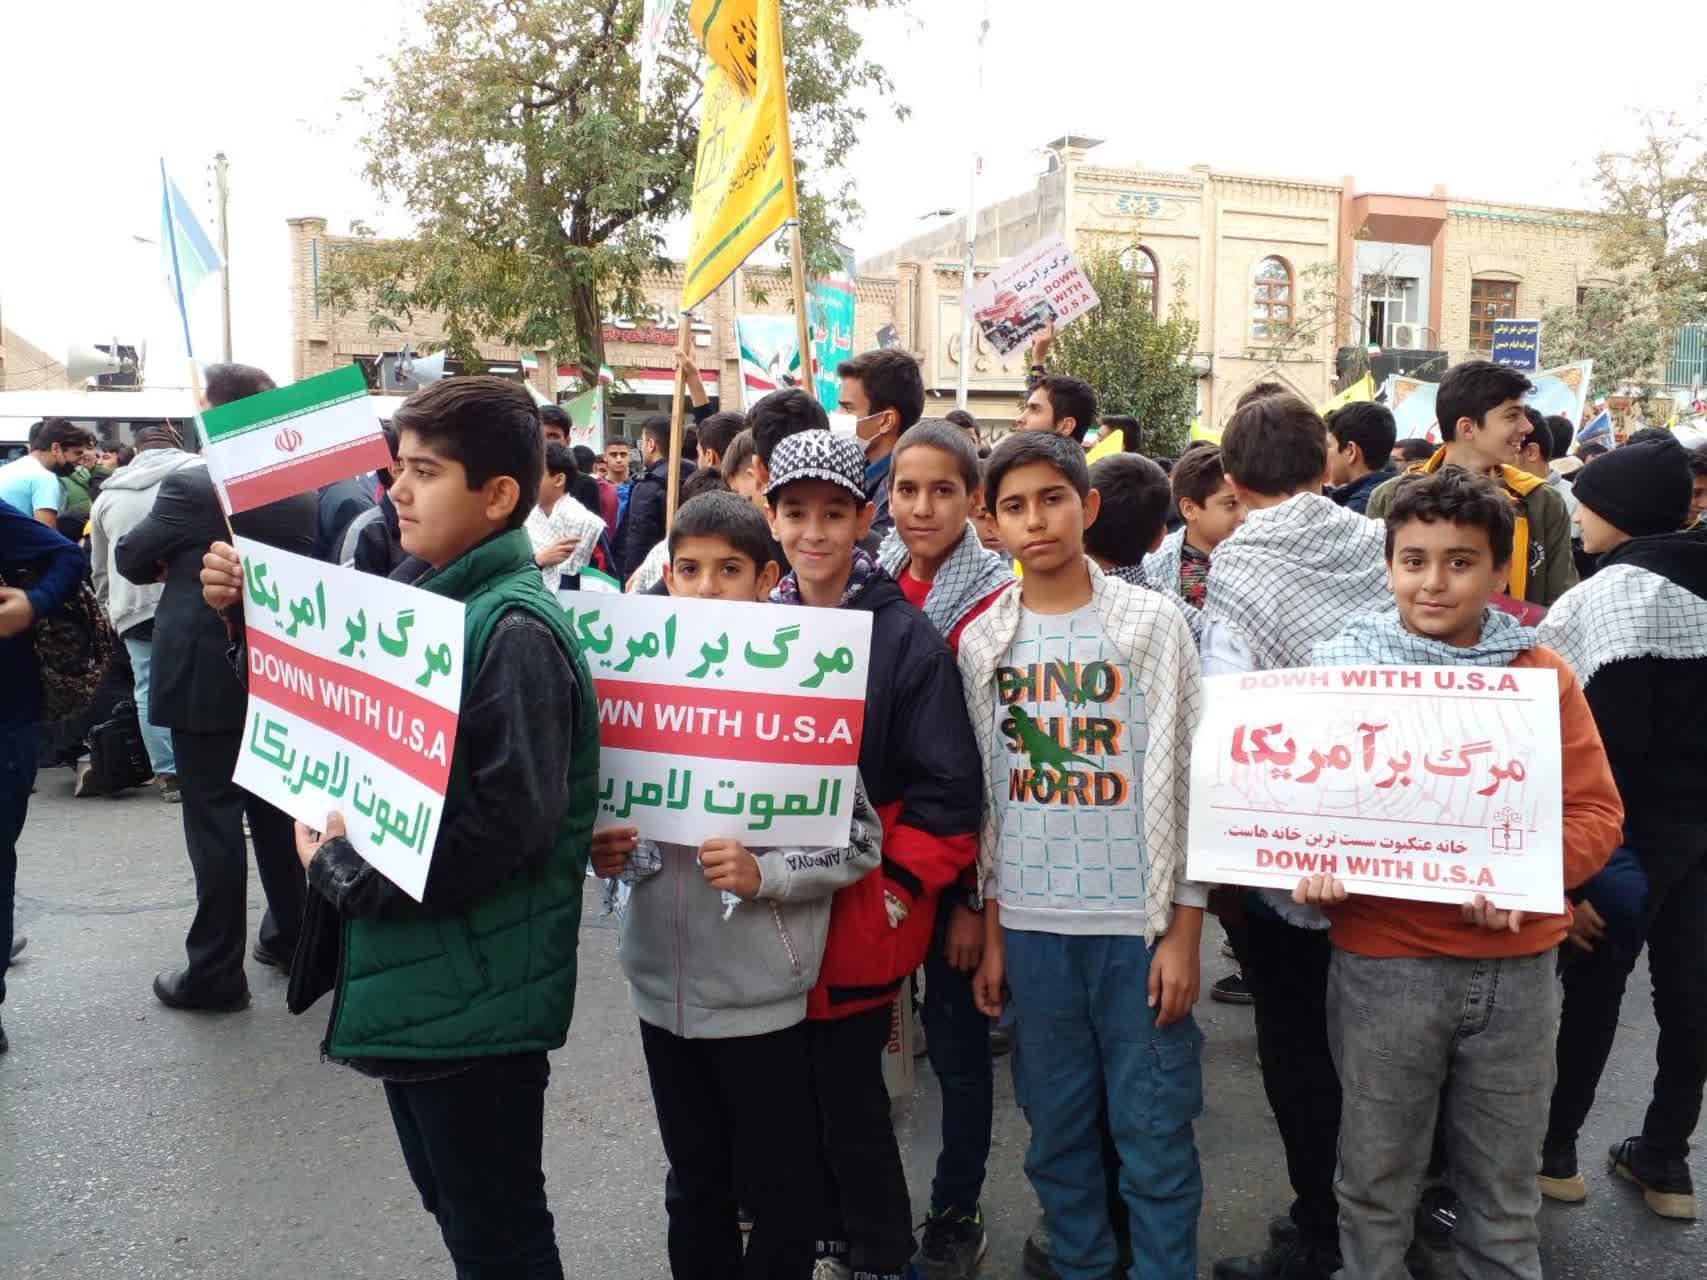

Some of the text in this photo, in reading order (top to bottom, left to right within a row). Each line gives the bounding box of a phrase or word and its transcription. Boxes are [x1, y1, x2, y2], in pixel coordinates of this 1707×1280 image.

[1043, 266, 1079, 296] DOWN
[1052, 281, 1084, 305] WITH
[244, 556, 452, 688] مرگ بر امریکا
[686, 632, 729, 678] بر
[743, 624, 854, 688] مرگ
[996, 660, 1123, 705] DINO
[1341, 669, 1422, 688] WITH
[1434, 671, 1520, 693] U.S.A
[250, 646, 447, 768] DOWN WITH U.S.A
[597, 697, 853, 744] WN WITH U.S.A
[1001, 713, 1123, 757] SUR
[1230, 722, 1527, 797] مرگ بر آمریکا
[250, 712, 432, 855] الموت لامریکا
[599, 768, 692, 818] لامری
[704, 779, 842, 830] الموت
[1009, 768, 1130, 807] WORD
[1271, 826, 1302, 841] خانه
[1339, 836, 1377, 848] سست
[1379, 836, 1433, 854] عنکبوت
[1436, 839, 1468, 854] خانه
[1346, 855, 1414, 879] WITH
[1422, 863, 1496, 888] U.S.A
